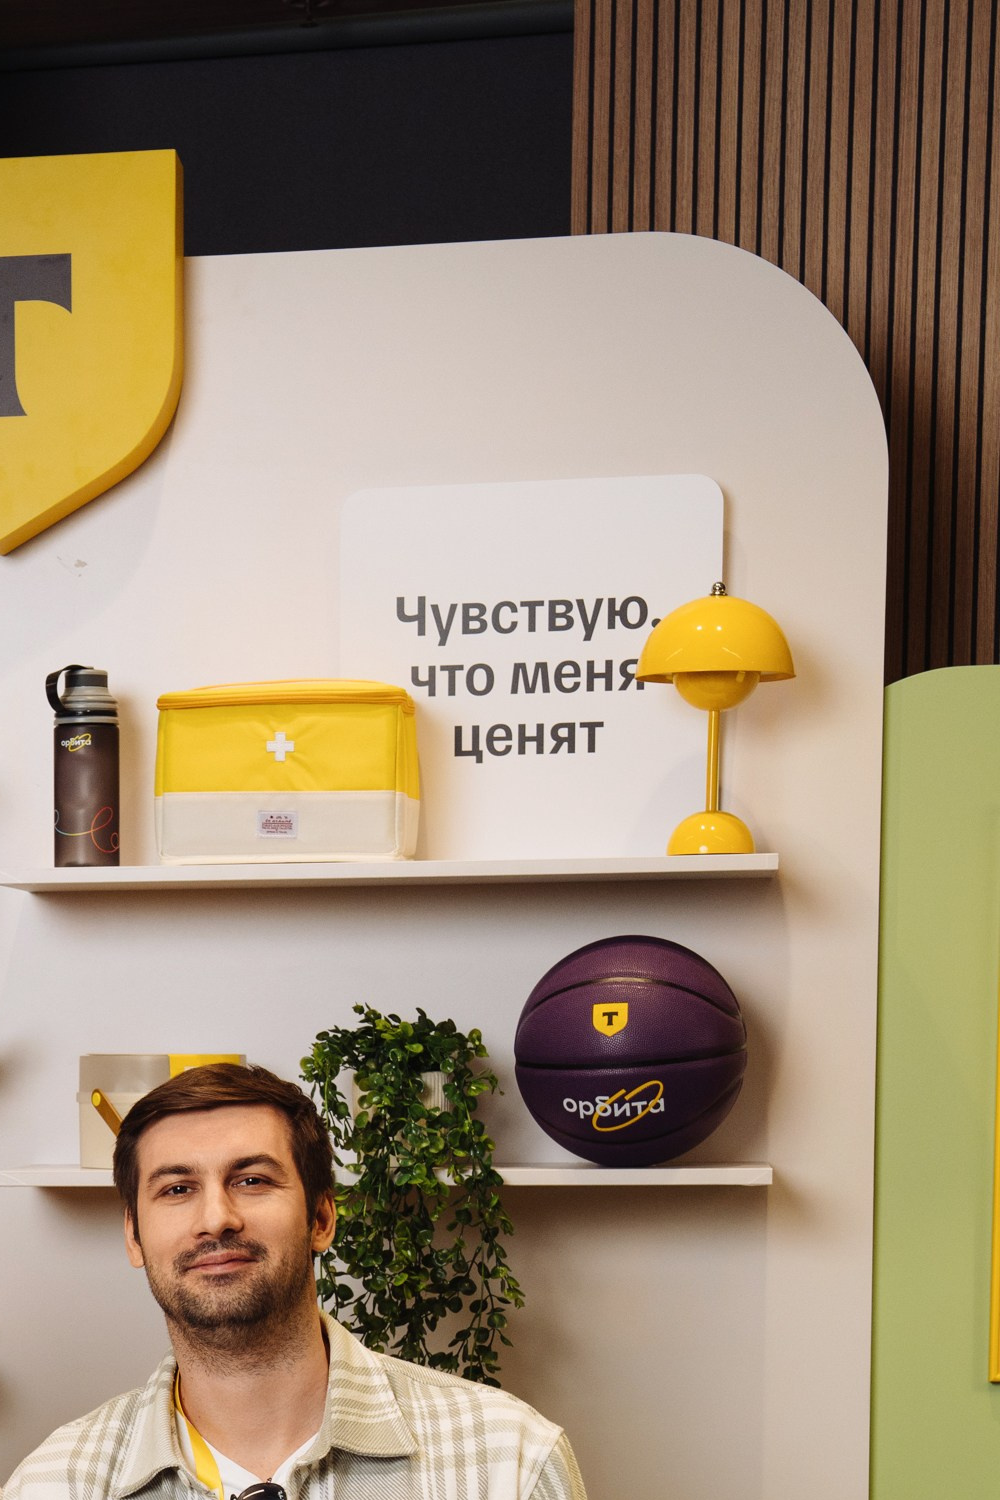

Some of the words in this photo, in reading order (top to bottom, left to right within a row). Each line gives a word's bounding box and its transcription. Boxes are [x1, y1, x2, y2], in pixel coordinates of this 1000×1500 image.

[410, 662, 495, 697] что
[510, 658, 645, 695] меня
[60, 737, 92, 748] орбита
[454, 721, 604, 764] ценят
[602, 1011, 618, 1026] Т
[561, 1093, 666, 1121] орбита
